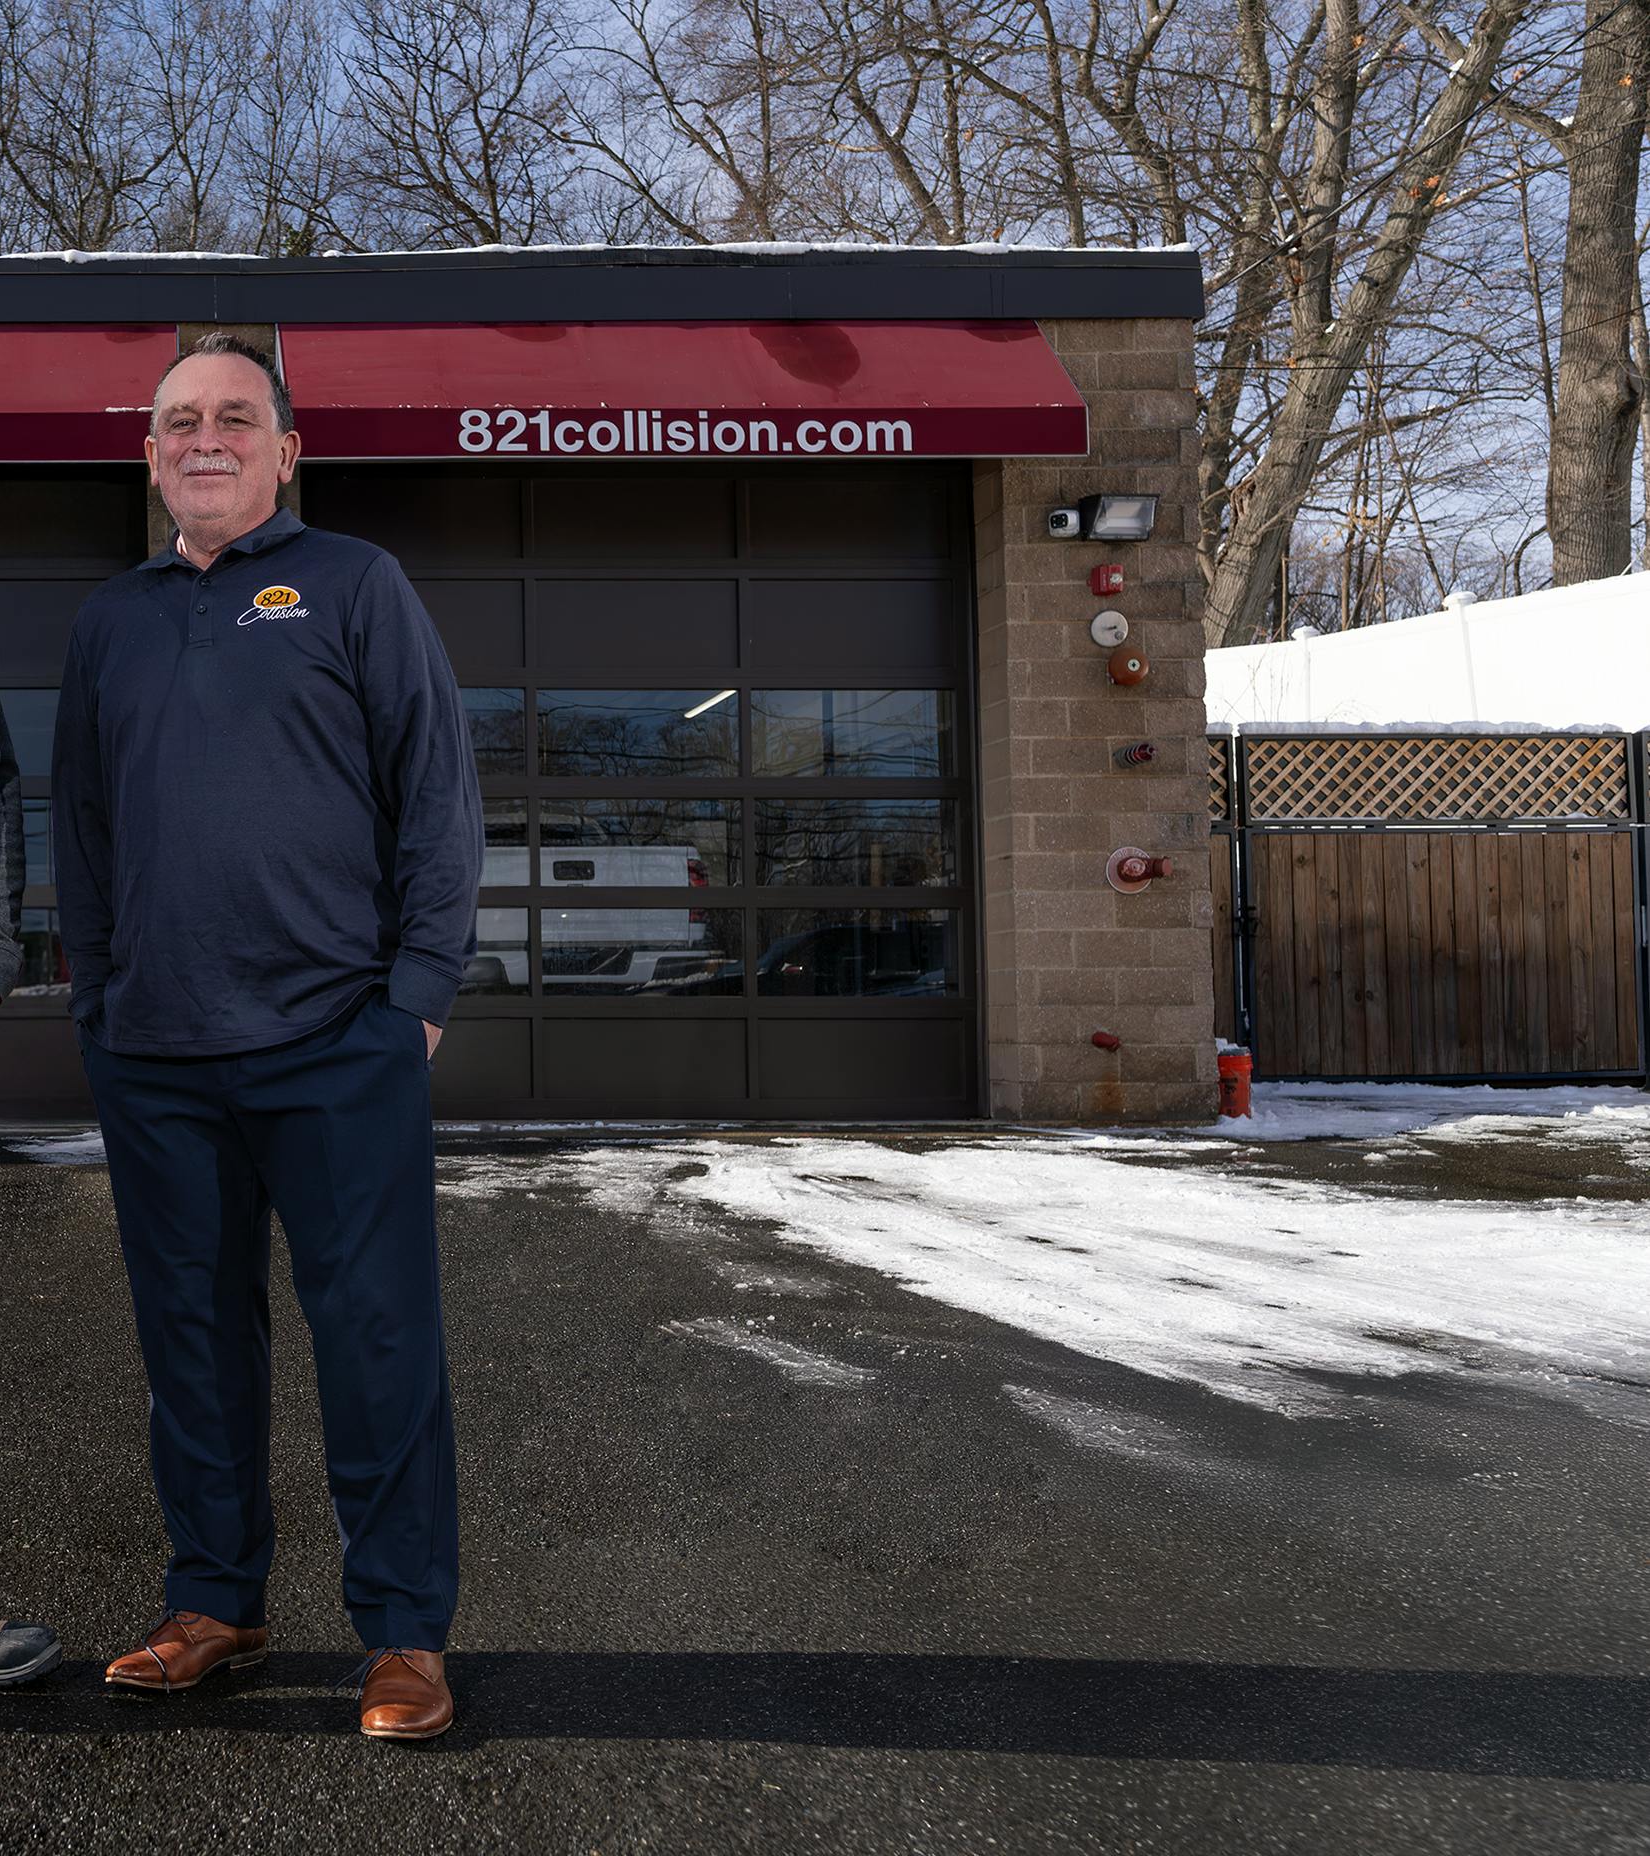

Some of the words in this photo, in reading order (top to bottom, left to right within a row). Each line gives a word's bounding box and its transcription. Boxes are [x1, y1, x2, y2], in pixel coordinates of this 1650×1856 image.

[457, 409, 913, 454] 821collision.com
[260, 589, 292, 606] 821
[237, 605, 310, 626] Collision
